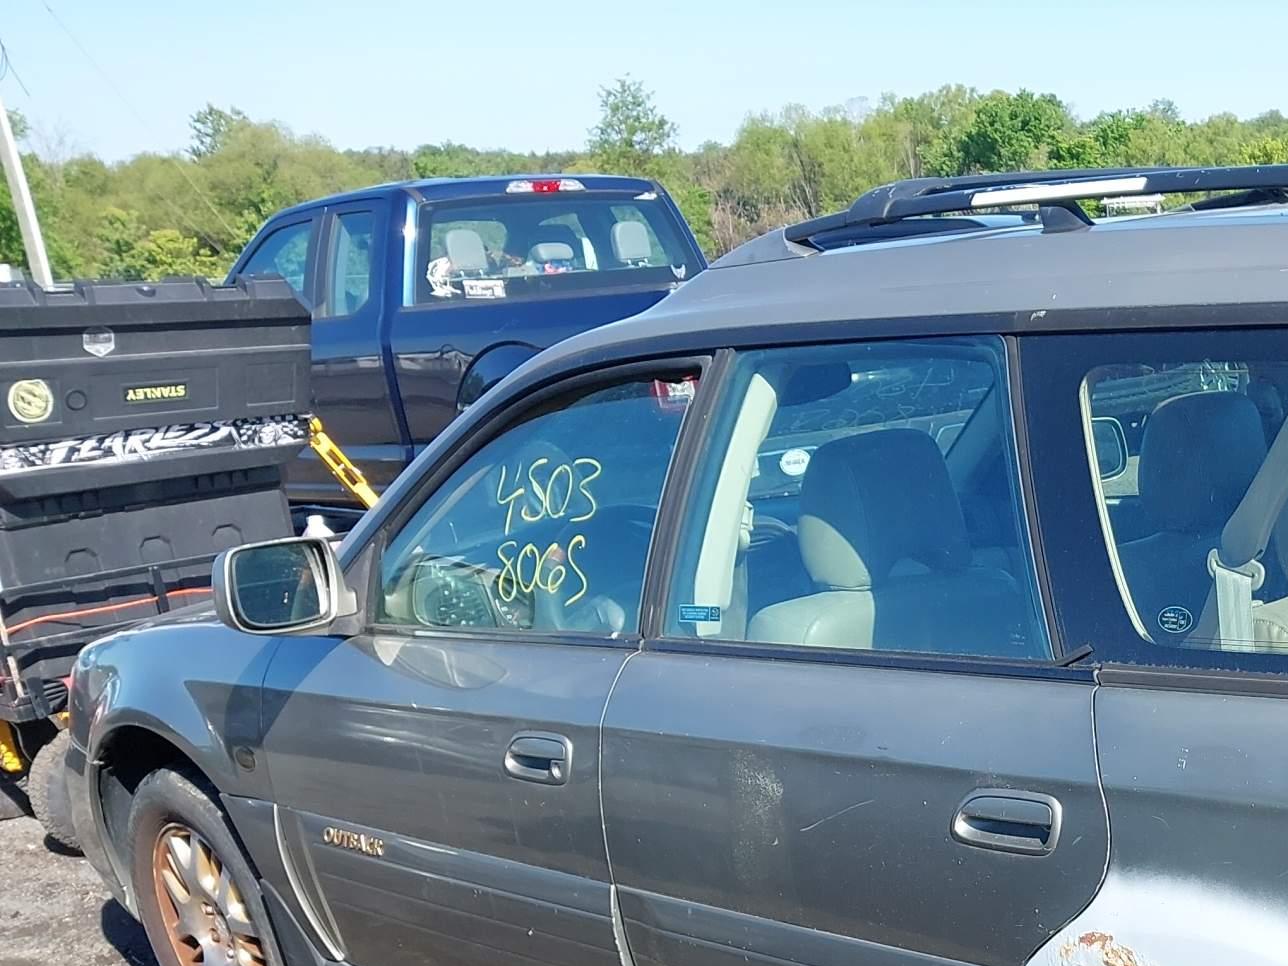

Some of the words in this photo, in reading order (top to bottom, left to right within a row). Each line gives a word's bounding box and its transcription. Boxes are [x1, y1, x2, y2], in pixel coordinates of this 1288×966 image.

[126, 385, 186, 401] STANLEY
[497, 457, 602, 536] 4503
[497, 534, 588, 607] 8065
[322, 826, 385, 857] OUTBACK
